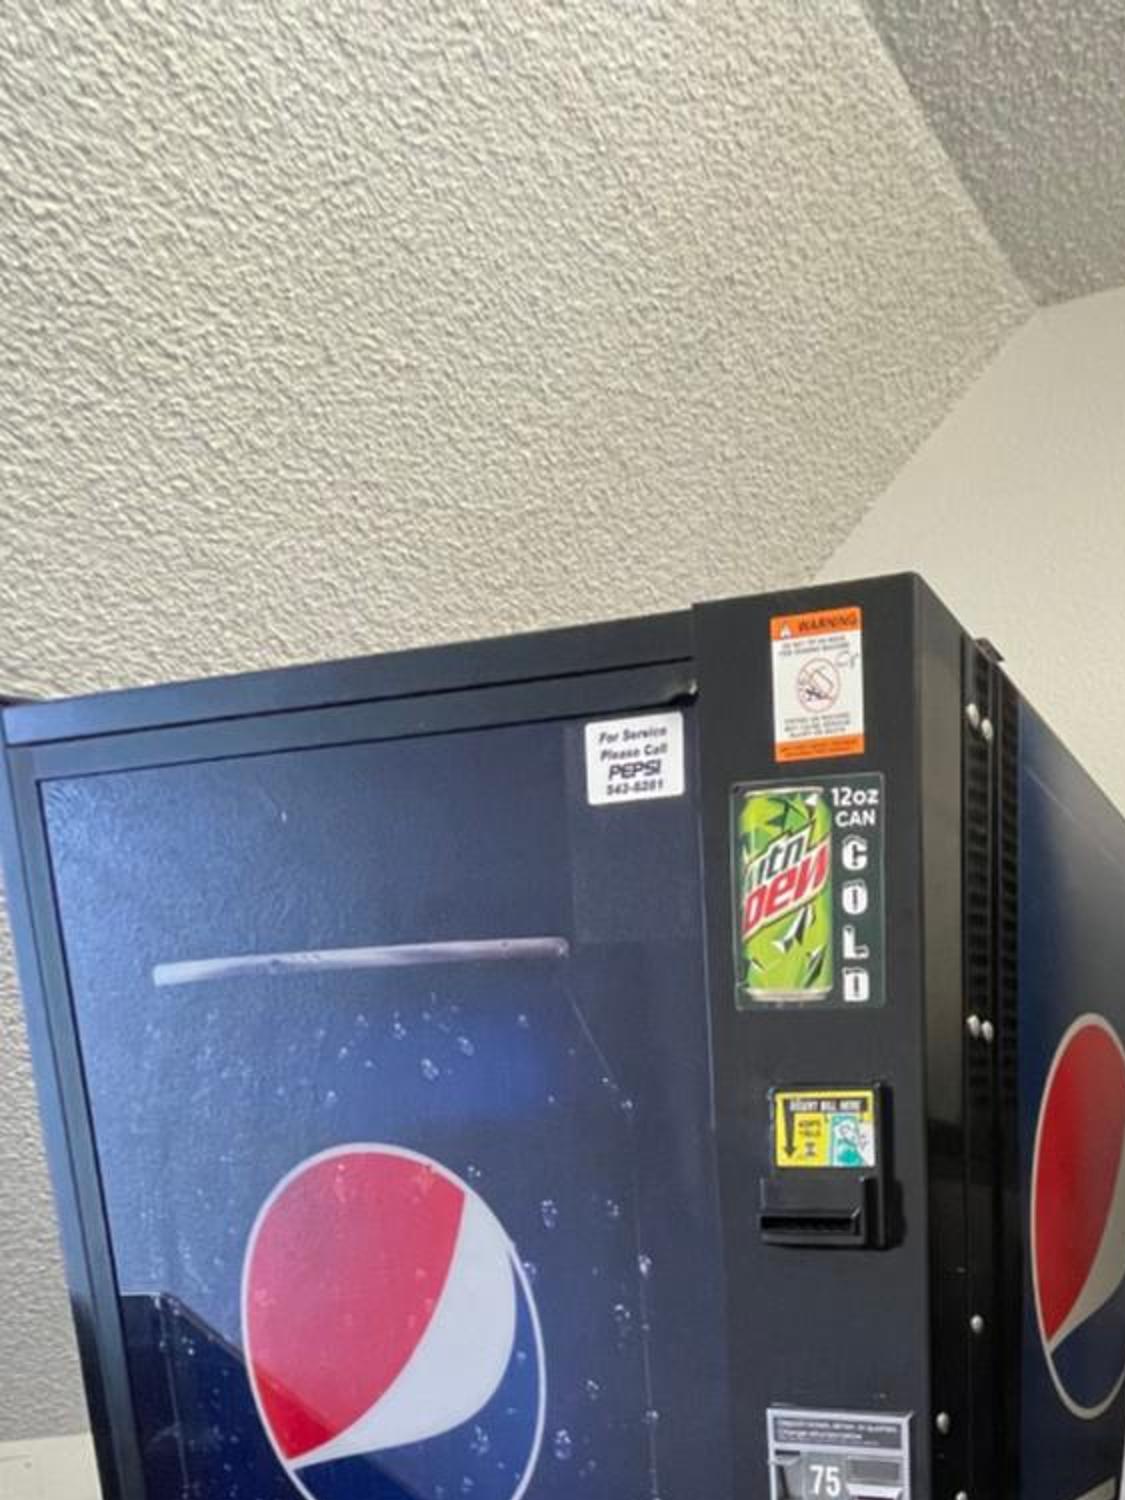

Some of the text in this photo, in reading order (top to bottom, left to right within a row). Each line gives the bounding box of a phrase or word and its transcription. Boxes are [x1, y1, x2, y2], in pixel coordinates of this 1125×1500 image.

[798, 614, 859, 633] WARNING
[599, 726, 667, 743] For Service
[600, 742, 668, 762] Please Call
[608, 758, 662, 780] PEPSI
[831, 787, 880, 806] 12oz
[835, 810, 876, 827] CAN
[809, 1464, 841, 1498] 75
